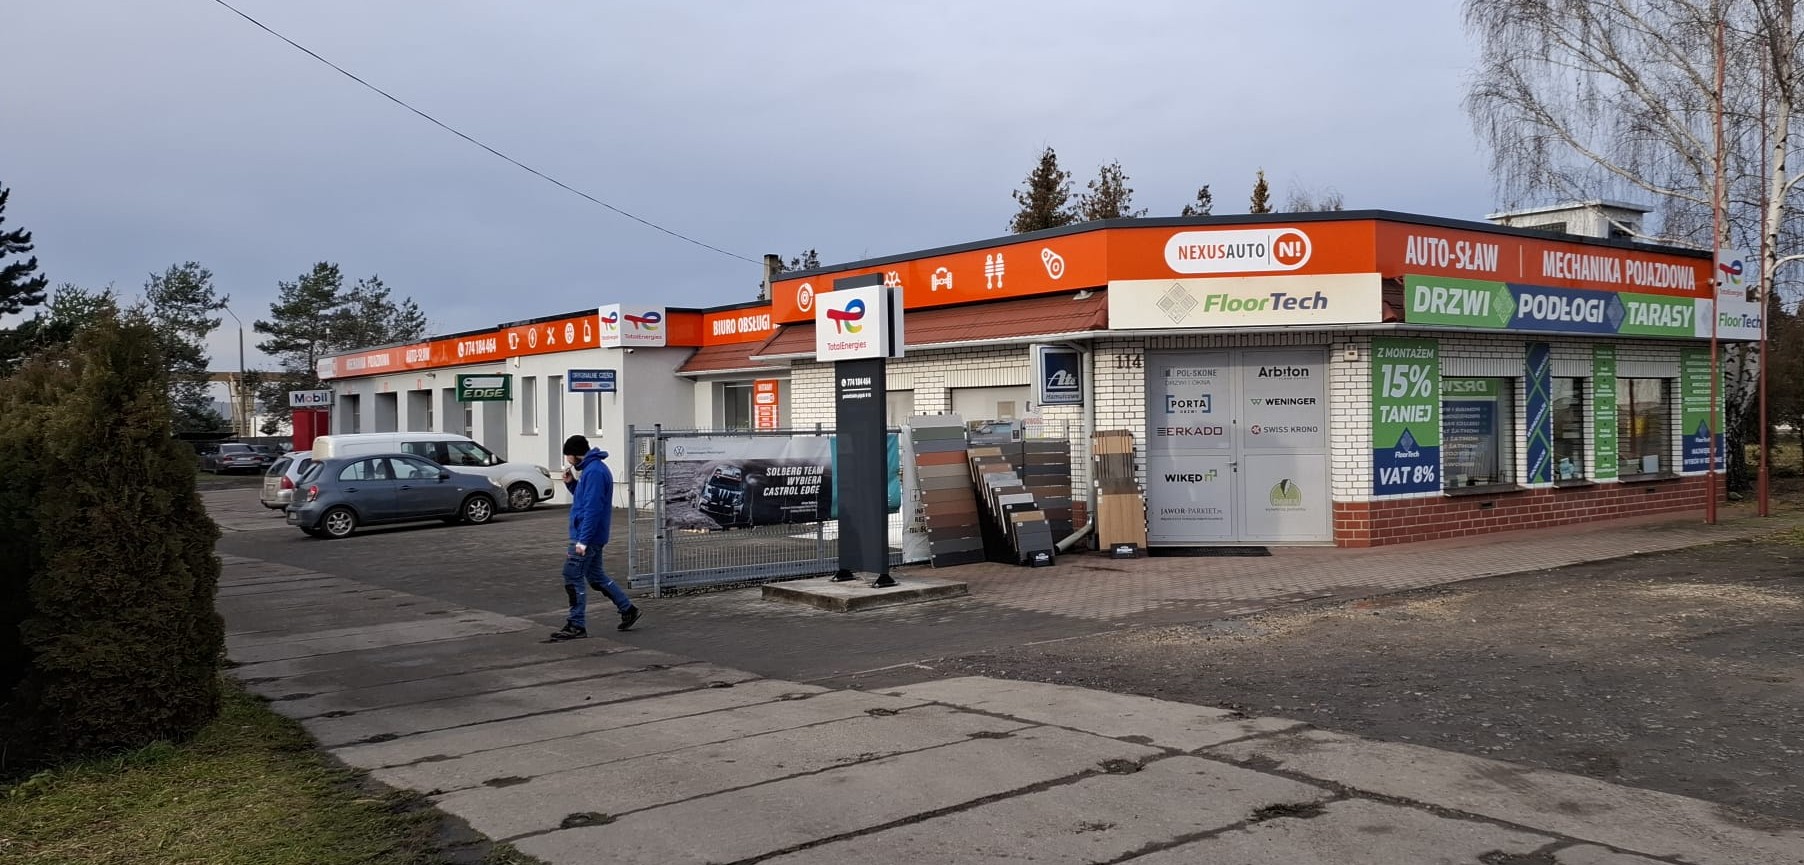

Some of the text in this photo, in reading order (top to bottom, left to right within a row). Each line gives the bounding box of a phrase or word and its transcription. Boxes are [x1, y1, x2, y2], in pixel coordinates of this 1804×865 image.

[1178, 243, 1265, 260] NEXUSAUTO
[1278, 240, 1302, 258] N!
[1405, 235, 1695, 290] AUTO-SŁAW MECHANIKA POJAZDOWA
[1203, 291, 1328, 313] FloorTech
[1413, 285, 1694, 328] DRZWI PODŁOGI TARASY
[713, 314, 770, 336] BIURO OBSŁUGI
[1719, 312, 1761, 328] FloorTech
[624, 333, 662, 341] TotalEnergies
[827, 340, 867, 351] TotalEnergies
[1377, 345, 1434, 359] Z MONTAŻEM
[1114, 354, 1142, 369] 114
[1177, 369, 1217, 377] POL-SKONE
[1258, 366, 1309, 378] Arbiton
[1381, 364, 1432, 398] 15%
[294, 392, 328, 403] Mobil
[463, 389, 505, 398] EDGE
[1171, 400, 1206, 408] PORTA
[1265, 398, 1316, 406] WENINGER
[1380, 404, 1432, 423] TANIEJ
[1167, 427, 1223, 436] ERKADO
[1395, 450, 1420, 459] FloorTech
[766, 465, 825, 477] SOLBERG TEAM
[1379, 464, 1435, 485] VAT 8%
[787, 475, 822, 486] WYBIERA
[1165, 473, 1203, 484] WIKĘD
[763, 485, 820, 497] CASTROL EDGE
